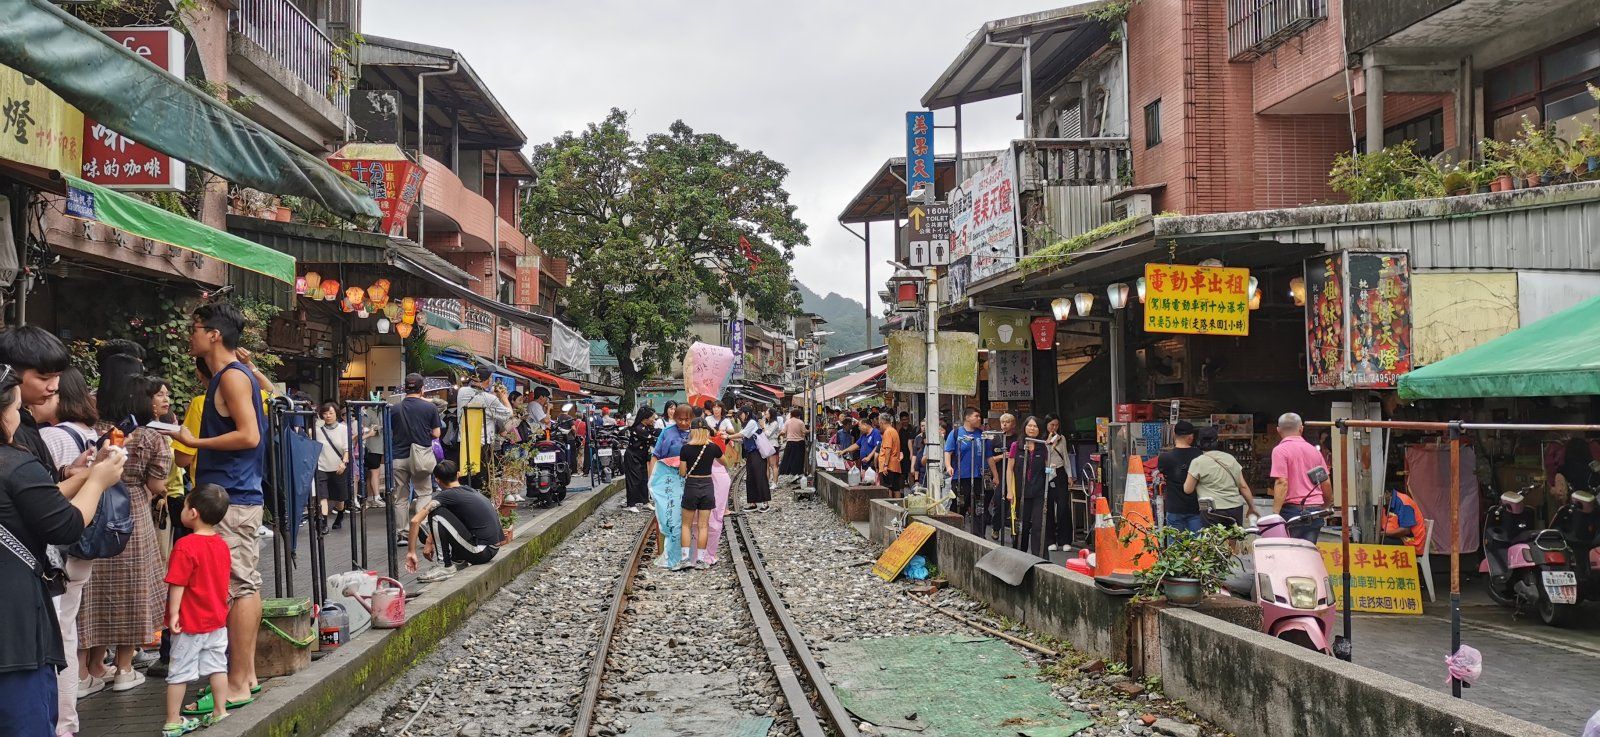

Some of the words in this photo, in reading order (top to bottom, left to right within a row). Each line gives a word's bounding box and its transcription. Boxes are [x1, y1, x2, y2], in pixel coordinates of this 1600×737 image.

[3, 73, 35, 144] 燈
[82, 157, 163, 180] 味的咖啡
[926, 207, 949, 215] 160M
[1149, 268, 1246, 296] 電動車出租
[1323, 258, 1339, 370] 三姐妹天燈
[1373, 256, 1401, 370] 三姐妹天燈
[1320, 546, 1413, 570] 動車出租
